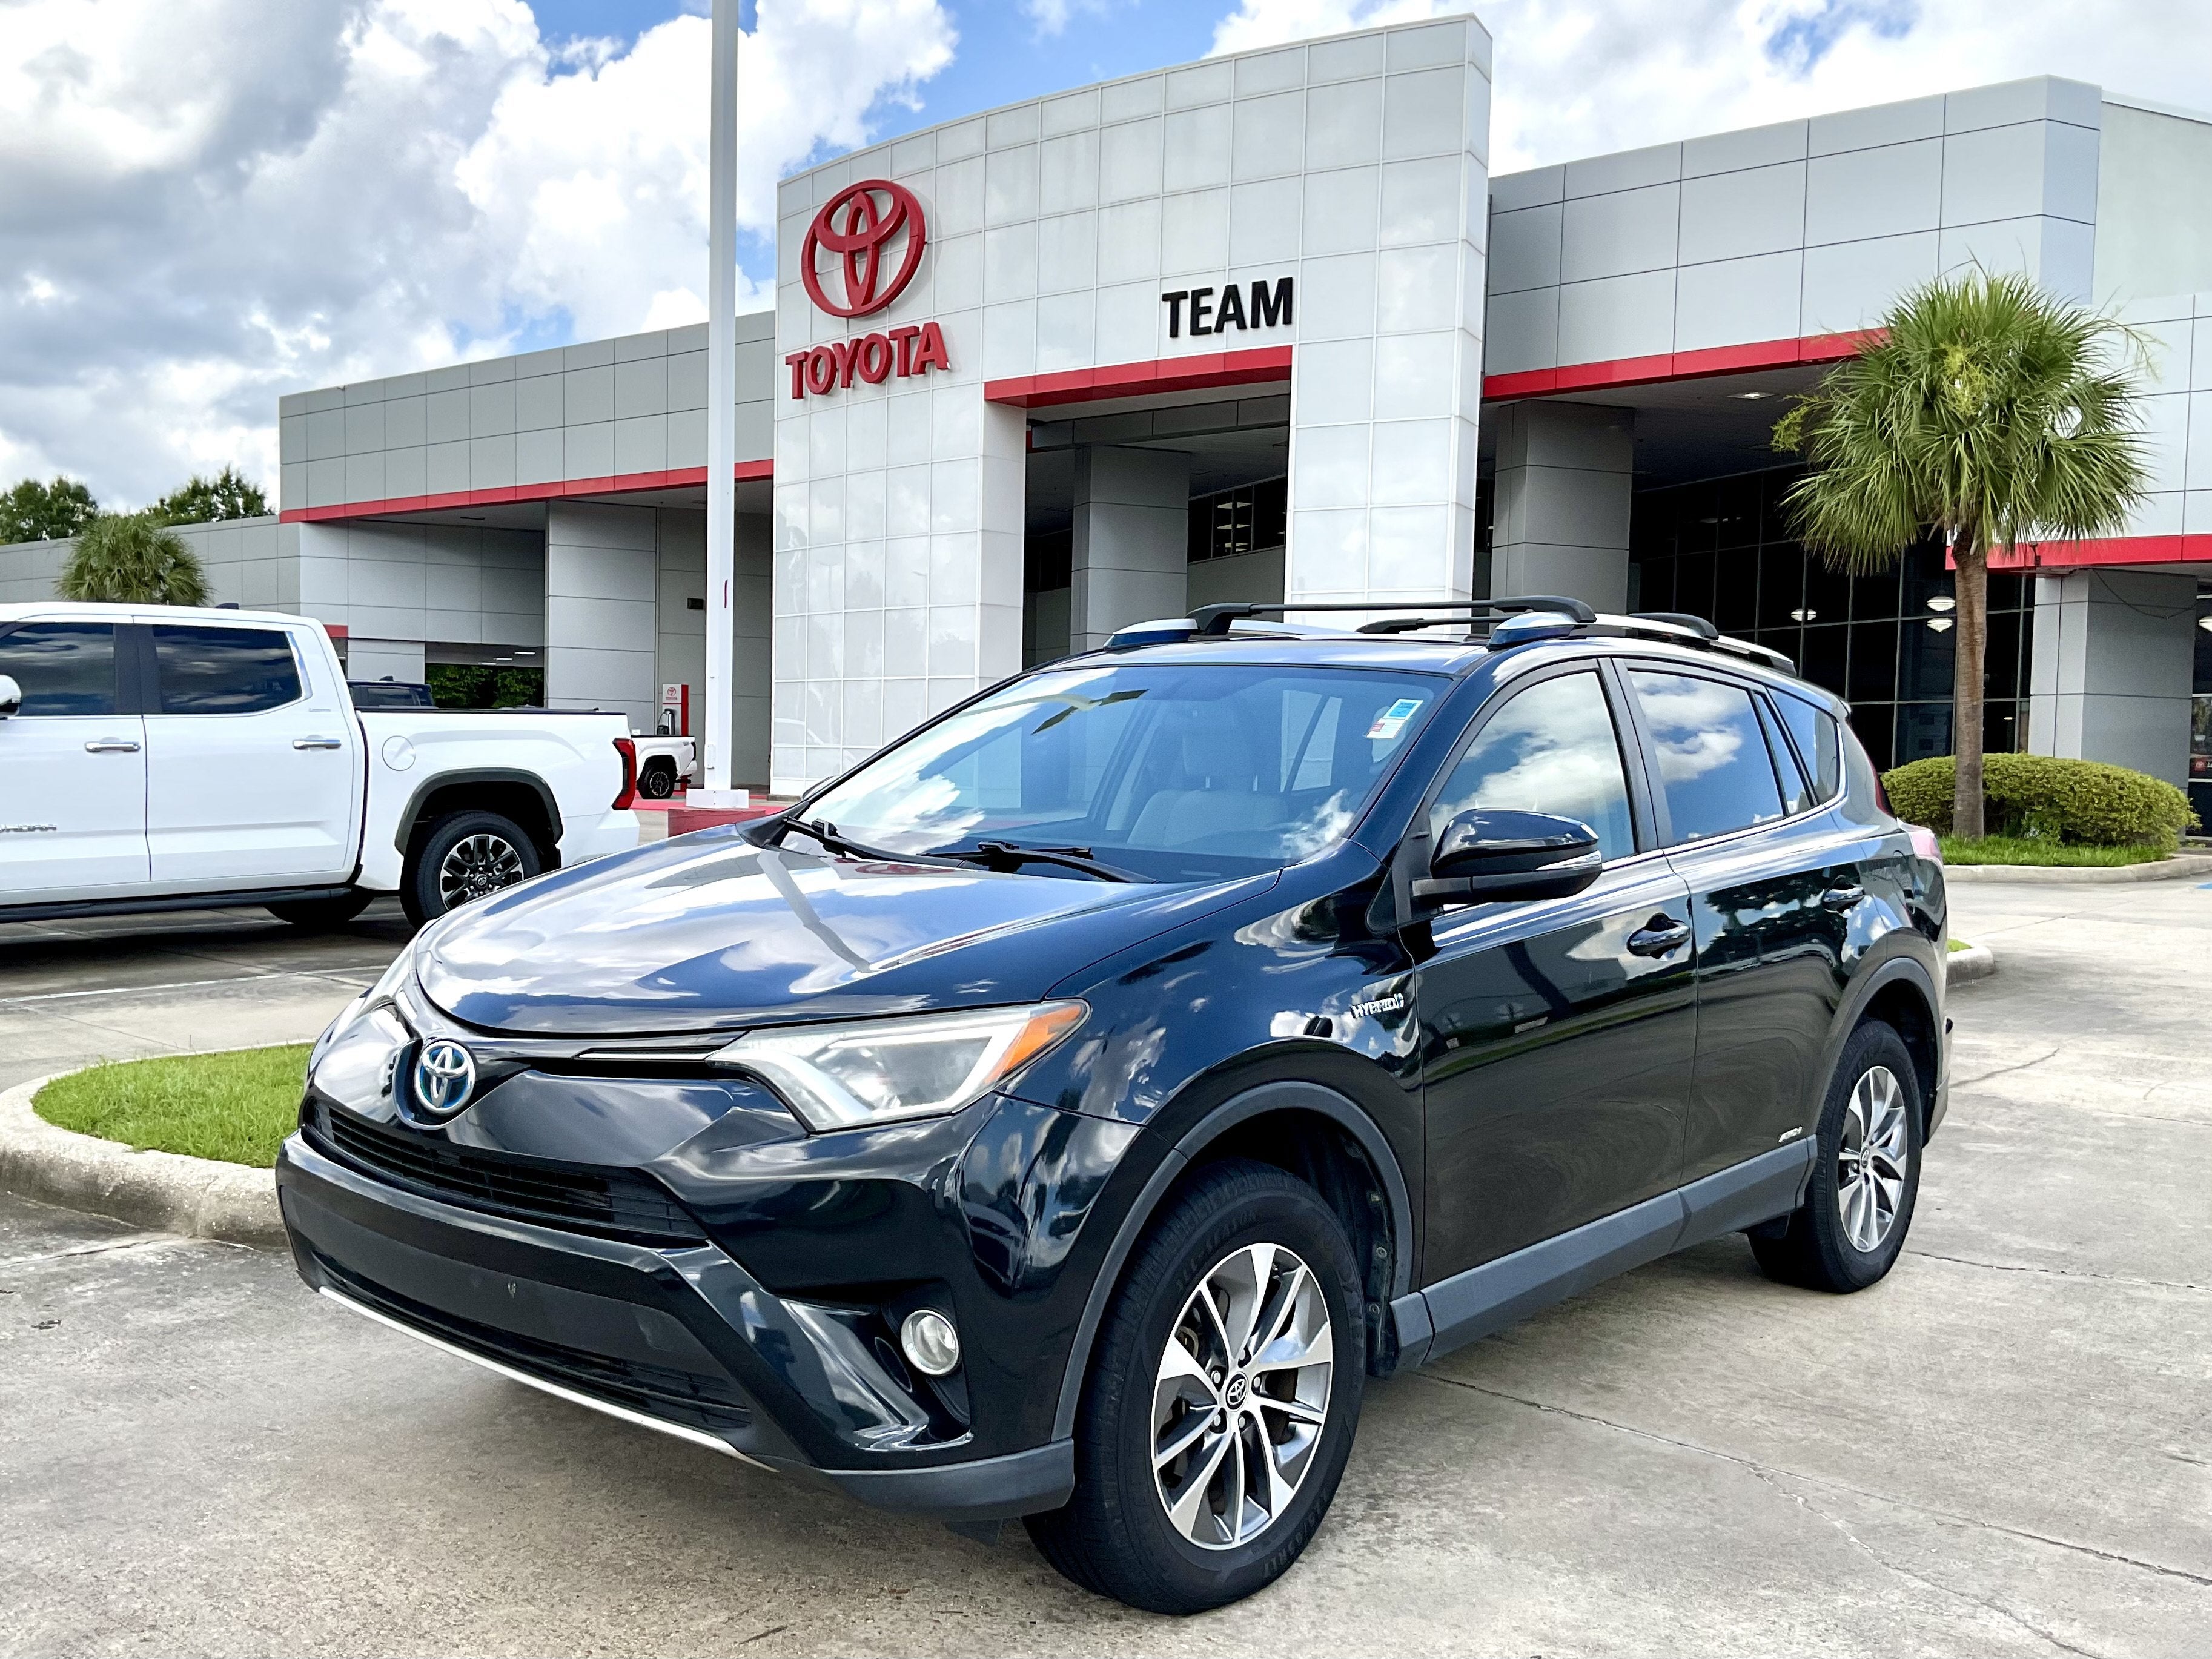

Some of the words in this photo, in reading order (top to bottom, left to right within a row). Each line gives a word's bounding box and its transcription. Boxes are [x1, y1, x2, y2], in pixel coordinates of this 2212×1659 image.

[1162, 277, 1294, 339] TEAM
[785, 322, 949, 400] TOYOTA
[1351, 996, 1396, 1018] HYBRID
